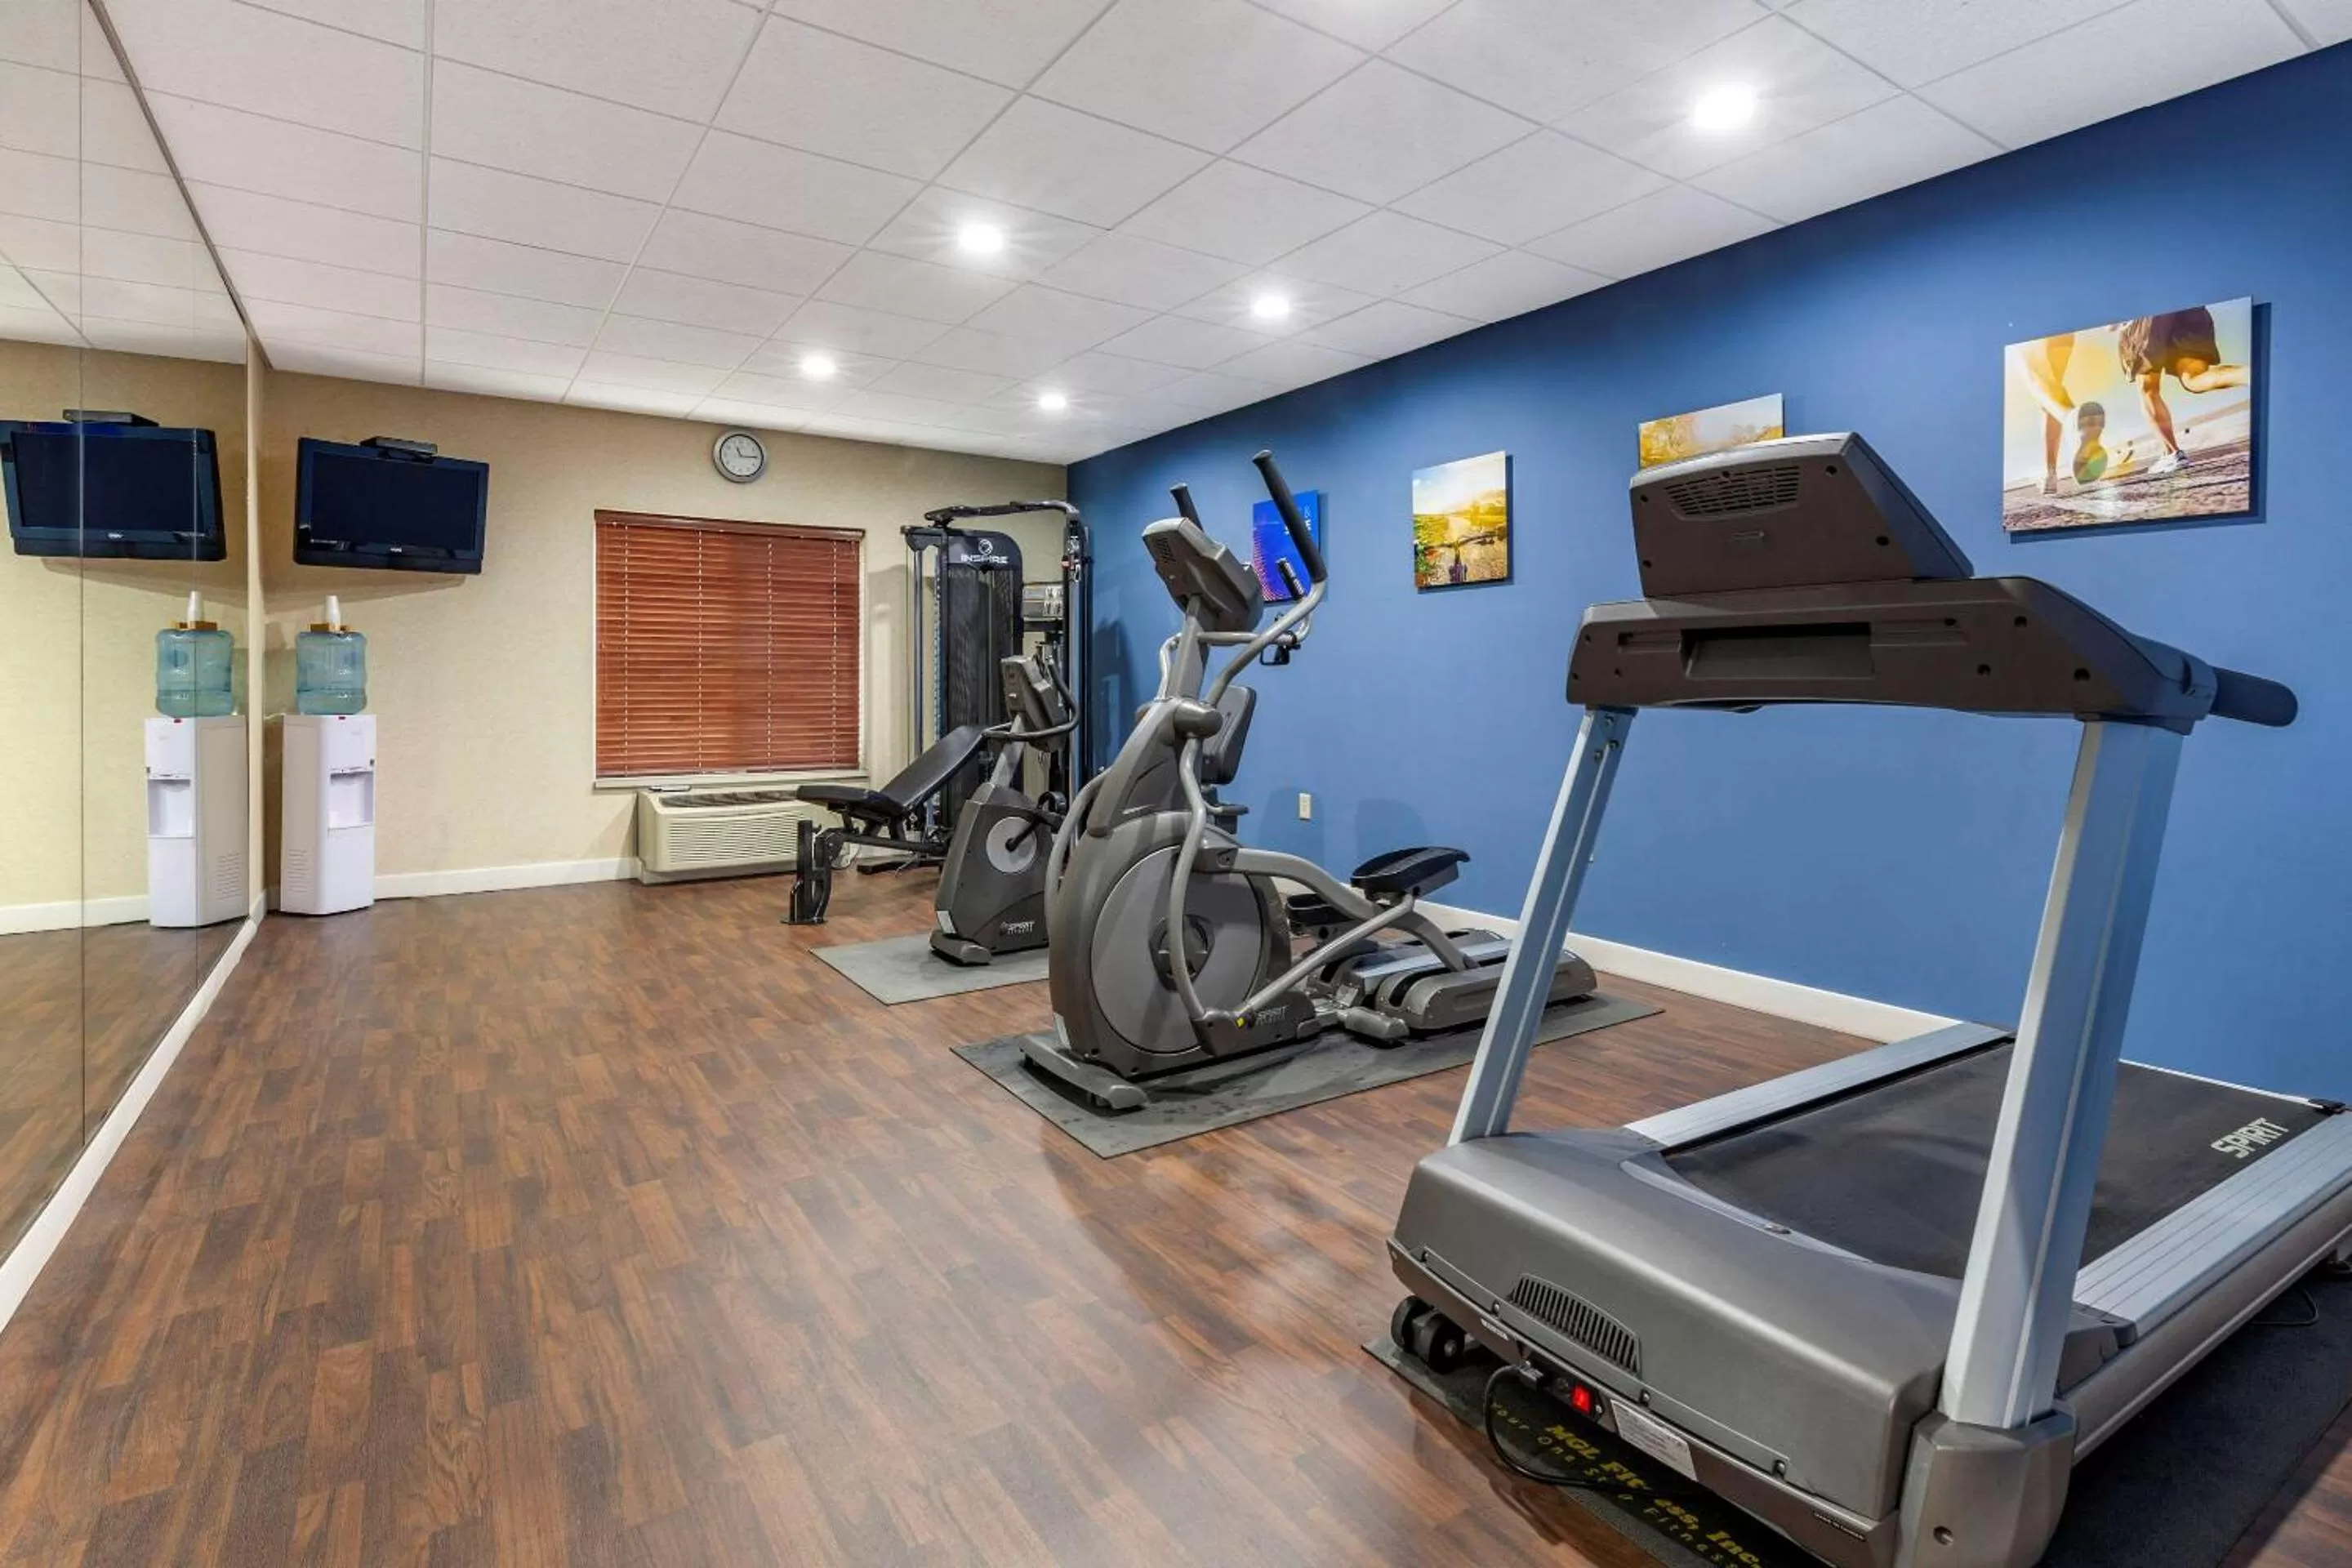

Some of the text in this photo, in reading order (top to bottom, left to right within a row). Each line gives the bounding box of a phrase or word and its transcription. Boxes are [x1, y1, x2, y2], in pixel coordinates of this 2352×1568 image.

[960, 554, 1009, 564] INSPIRE
[2210, 1116, 2289, 1159] SPIRIT
[1545, 1424, 1601, 1460] MGL
